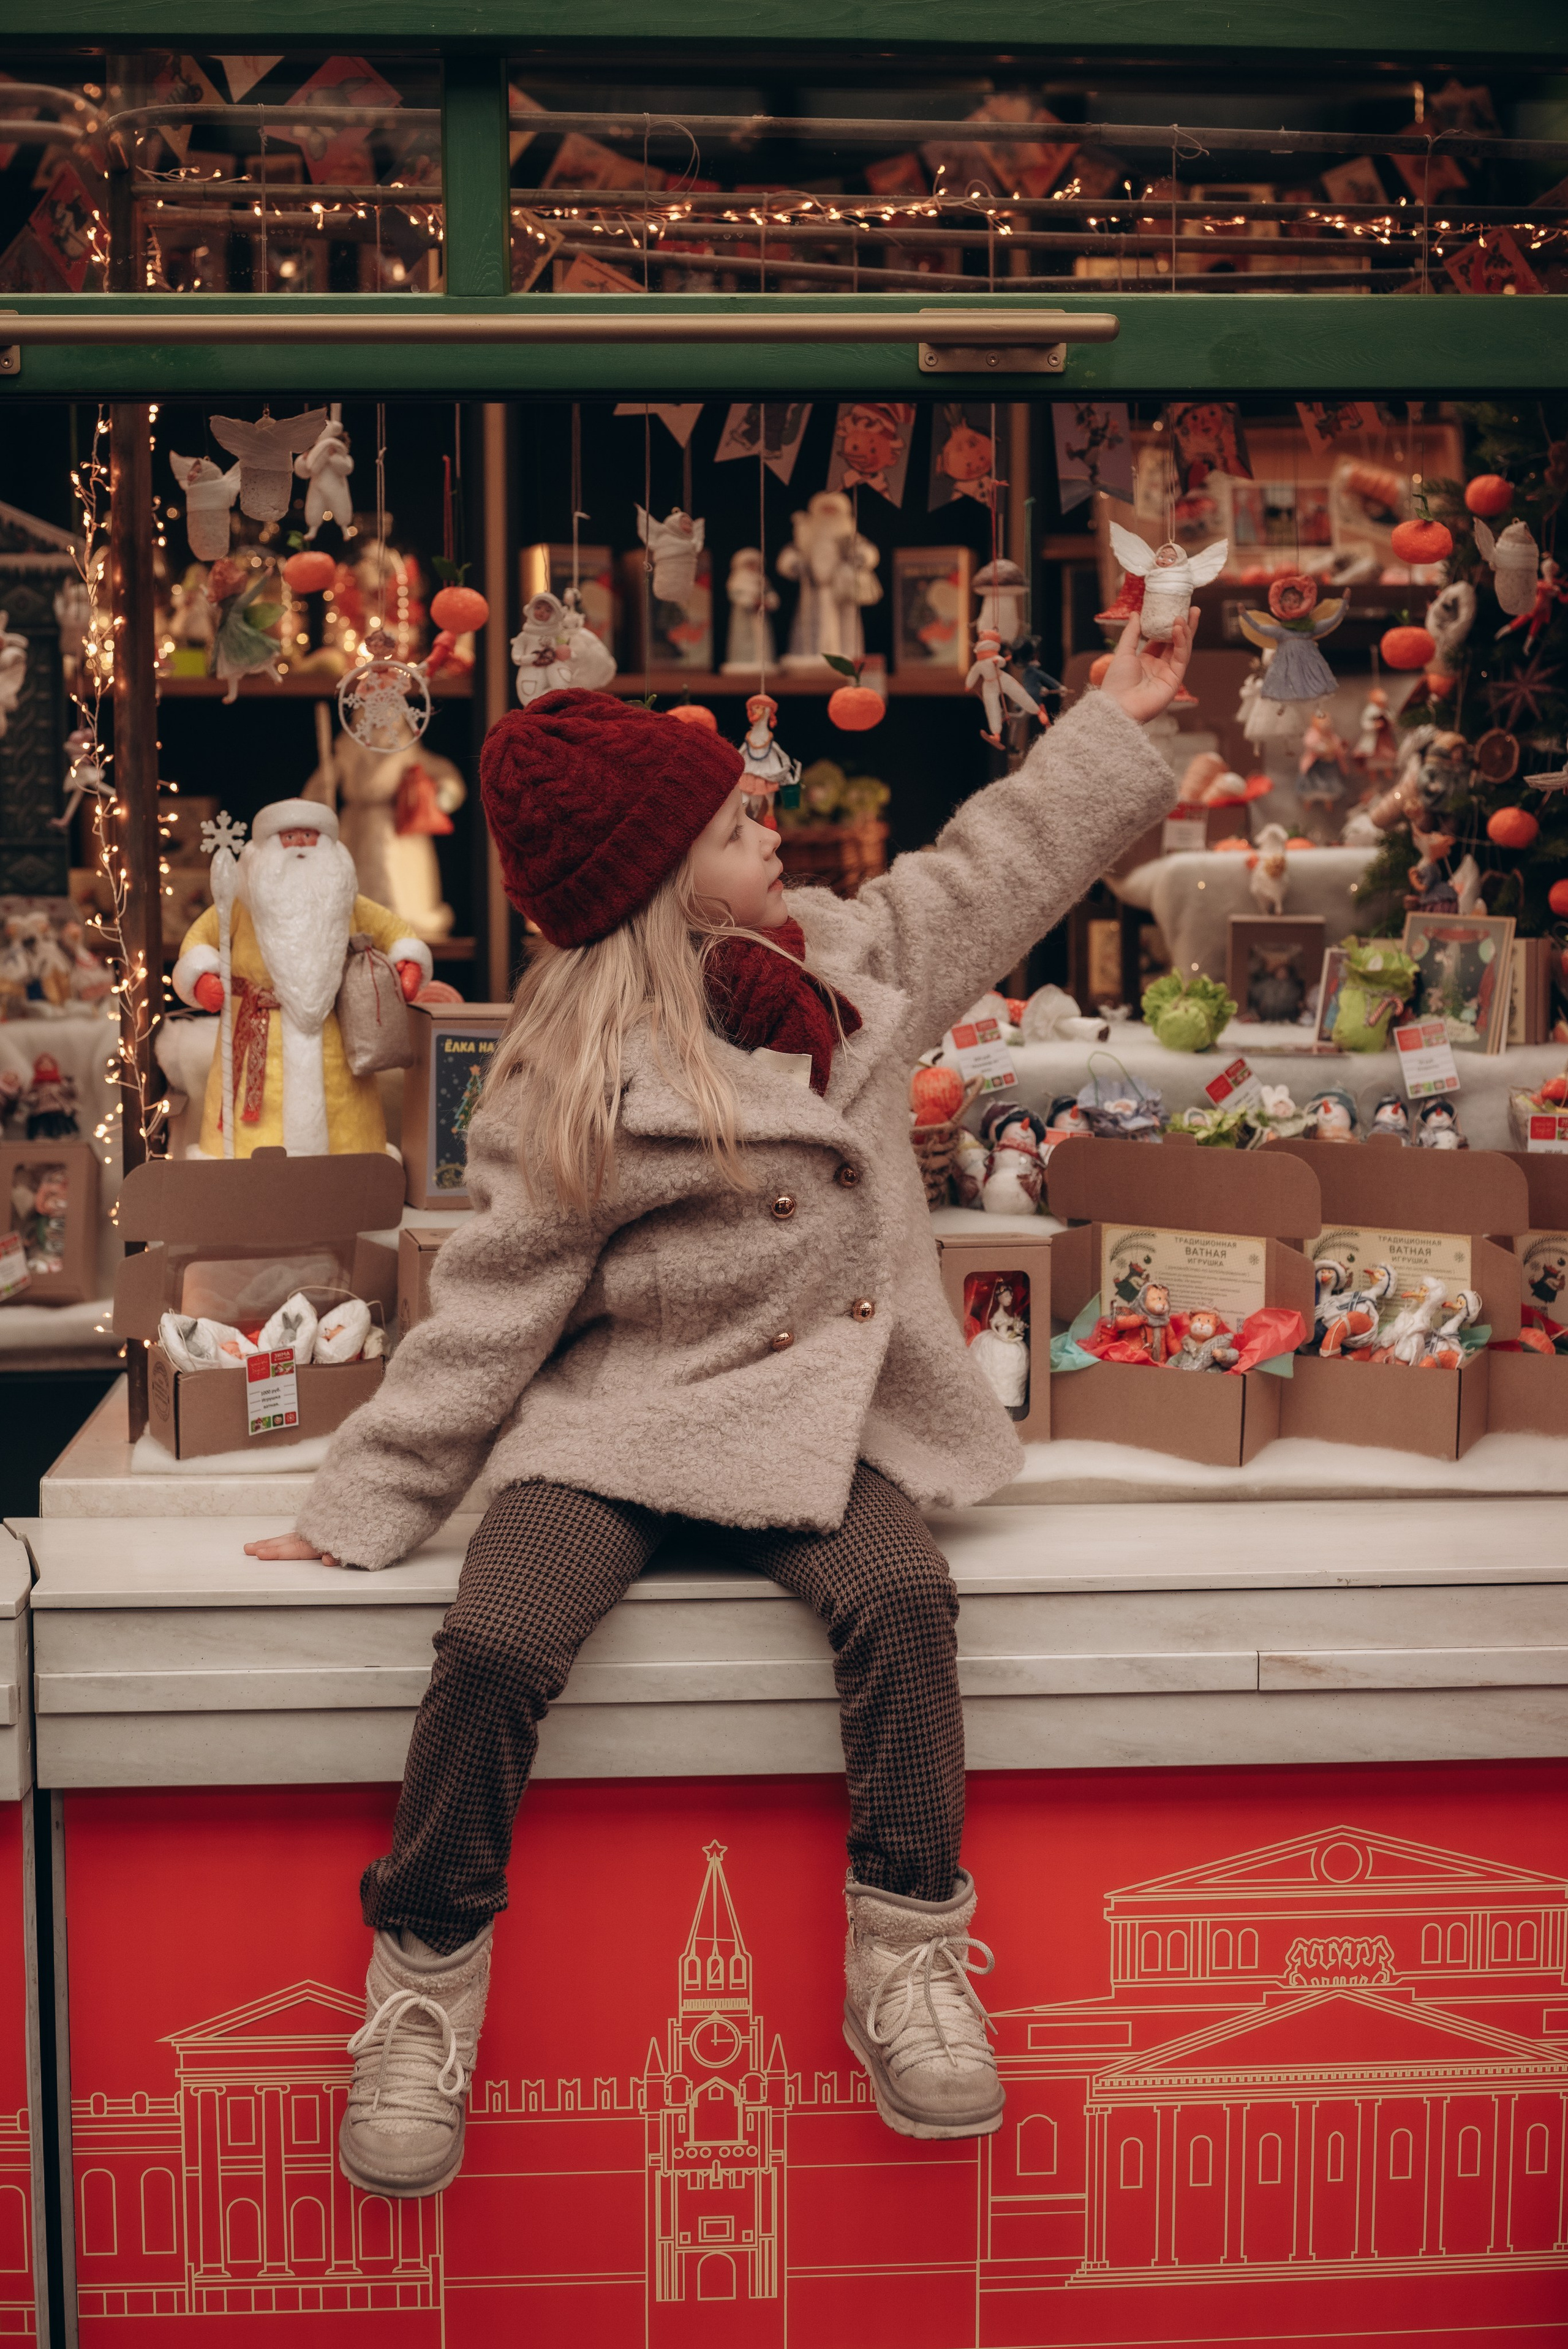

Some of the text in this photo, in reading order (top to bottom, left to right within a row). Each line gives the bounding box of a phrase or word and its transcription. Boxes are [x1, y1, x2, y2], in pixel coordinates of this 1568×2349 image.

[444, 1038, 475, 1053] ЁЛКА
[1175, 1236, 1237, 1248] ТРАДИЦИОННАЯ
[1378, 1235, 1442, 1247] ТРАДИЦИОННАЯ
[1185, 1246, 1227, 1259] ВАТНАЯ
[1389, 1245, 1431, 1257] ВАТНАЯ
[1188, 1257, 1224, 1267] ИГРУШКА
[1391, 1256, 1428, 1264] ИГРУШКА
